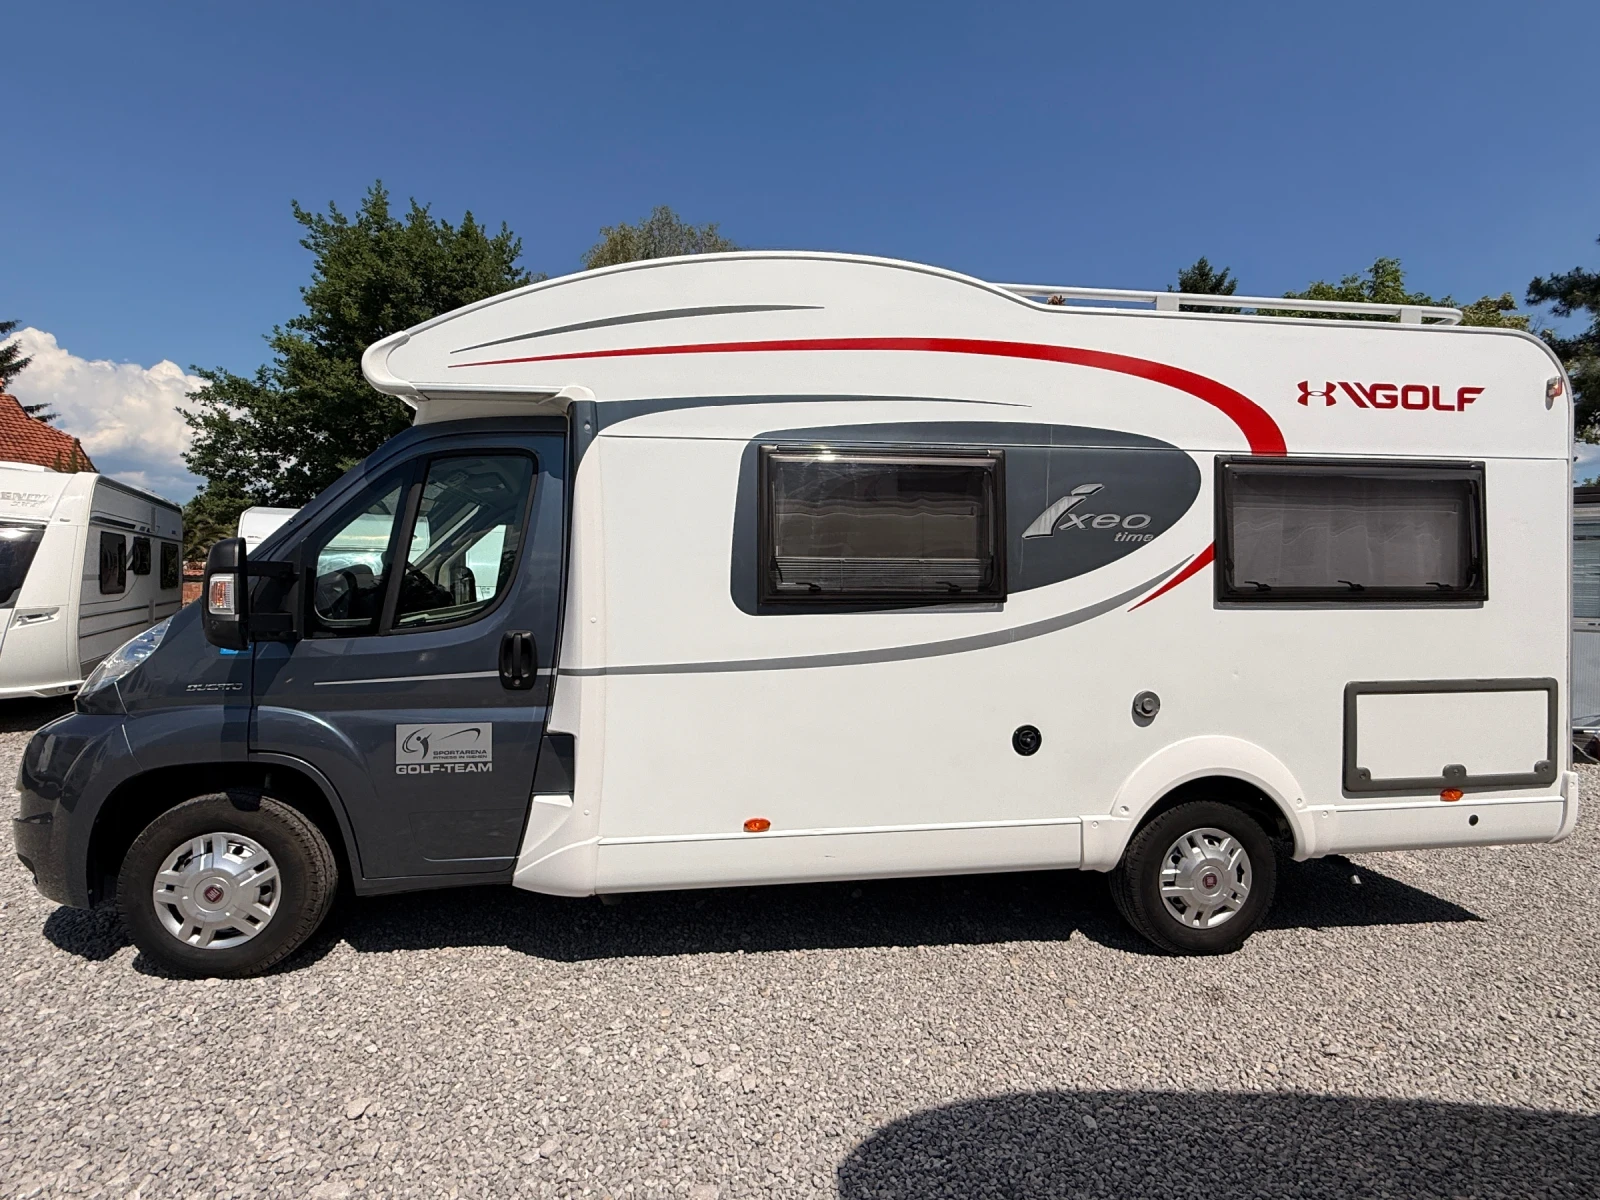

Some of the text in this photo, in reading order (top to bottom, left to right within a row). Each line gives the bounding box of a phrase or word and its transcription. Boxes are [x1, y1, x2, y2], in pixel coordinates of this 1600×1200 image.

[1368, 382, 1486, 412] GOLF
[1113, 531, 1154, 542] time
[185, 682, 244, 692] DUCATO
[395, 762, 493, 775] GOLF-TEAM
